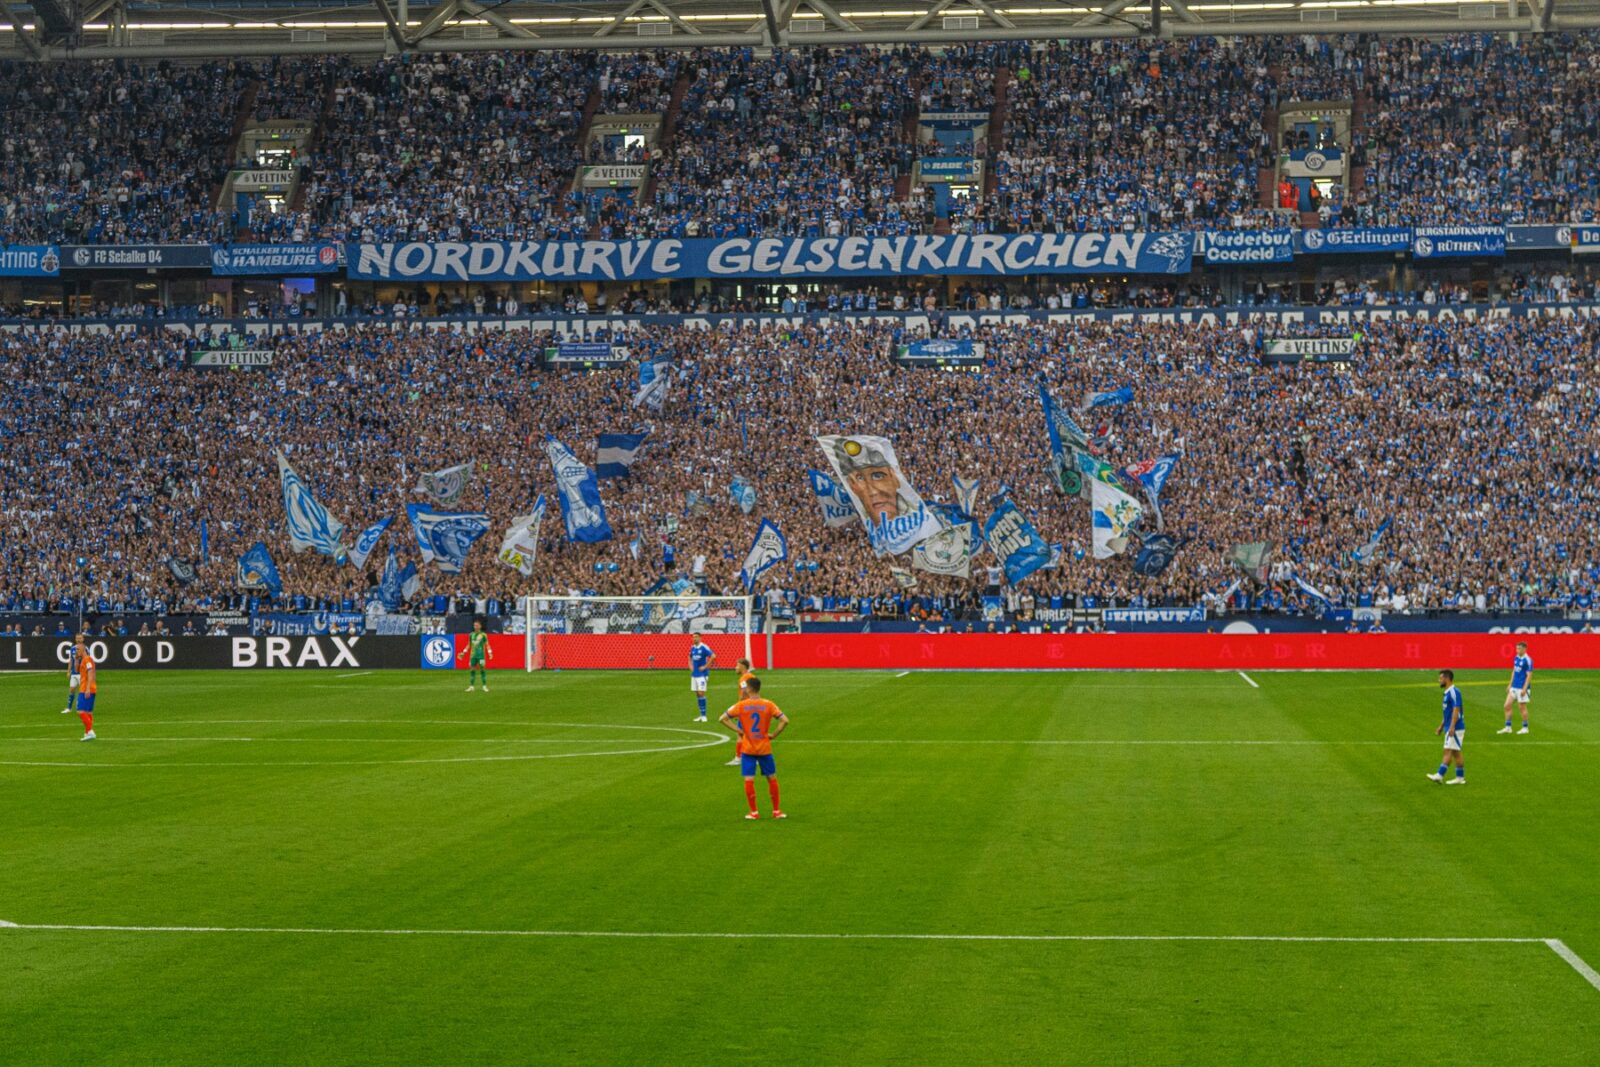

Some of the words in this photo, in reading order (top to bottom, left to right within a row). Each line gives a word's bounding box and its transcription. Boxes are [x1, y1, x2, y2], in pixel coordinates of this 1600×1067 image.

[251, 173, 295, 183] VELTINS
[601, 168, 644, 178] VELTINS
[232, 247, 280, 256] SCHALKER
[281, 246, 317, 255] FILIALE
[1437, 240, 1482, 252] RÜTHEN
[94, 249, 107, 263] FC
[108, 249, 147, 263] Schalke
[148, 249, 162, 263] 04
[357, 239, 684, 281] NORDKURVE
[706, 232, 1147, 275] GELSENKIRCHEN
[1206, 246, 1275, 261] Coesfeld
[232, 254, 318, 267] HAMBURG
[1293, 341, 1350, 354] VELTINS
[219, 351, 270, 364] VELTINS
[232, 636, 360, 668] BRAX
[751, 712, 761, 733] 2
